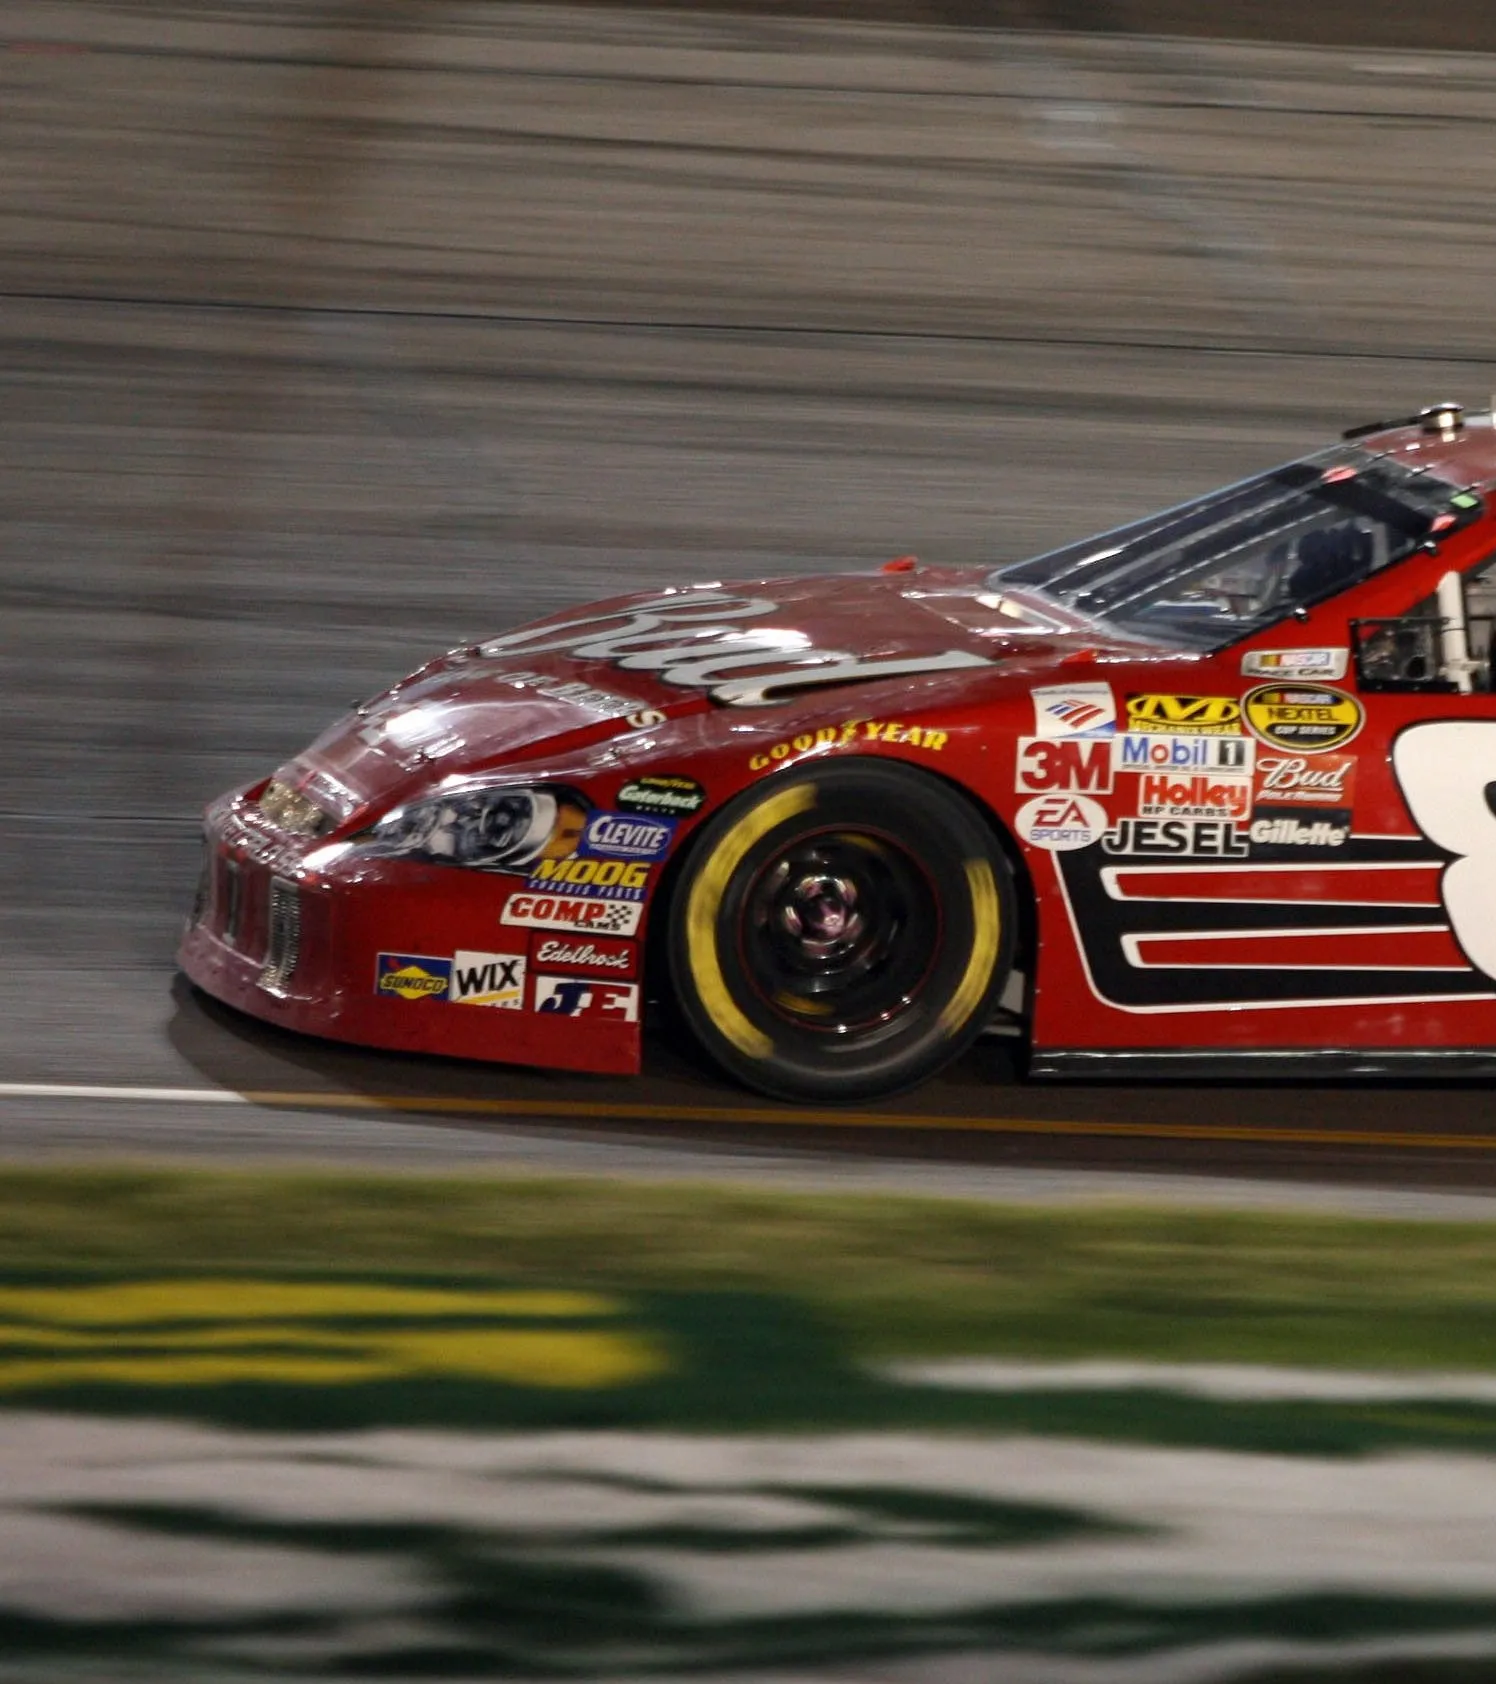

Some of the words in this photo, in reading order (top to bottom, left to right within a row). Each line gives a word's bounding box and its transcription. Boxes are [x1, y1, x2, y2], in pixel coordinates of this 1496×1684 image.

[1267, 707, 1341, 722] NEXTEL
[1273, 725, 1299, 735] CUP
[1299, 725, 1337, 736] SERIES
[1021, 741, 1110, 790] 3M
[1122, 736, 1208, 765] Mobil
[1222, 741, 1240, 766] 1
[1256, 758, 1351, 789] Bud
[1144, 776, 1248, 815] Holley
[1035, 798, 1091, 828] EA
[1142, 806, 1164, 815] HP
[1168, 807, 1229, 817] CARBS
[589, 816, 670, 849] CLEVITE
[1030, 828, 1091, 843] SPORTS
[1103, 821, 1249, 855] JESEL
[1250, 818, 1350, 847] Gillette
[529, 859, 652, 888] MOOG
[510, 898, 606, 922] COMP
[574, 920, 622, 931] CAMS
[536, 941, 631, 969] Edelbrock
[384, 974, 447, 993] SUNOCO
[456, 959, 521, 996] WIX
